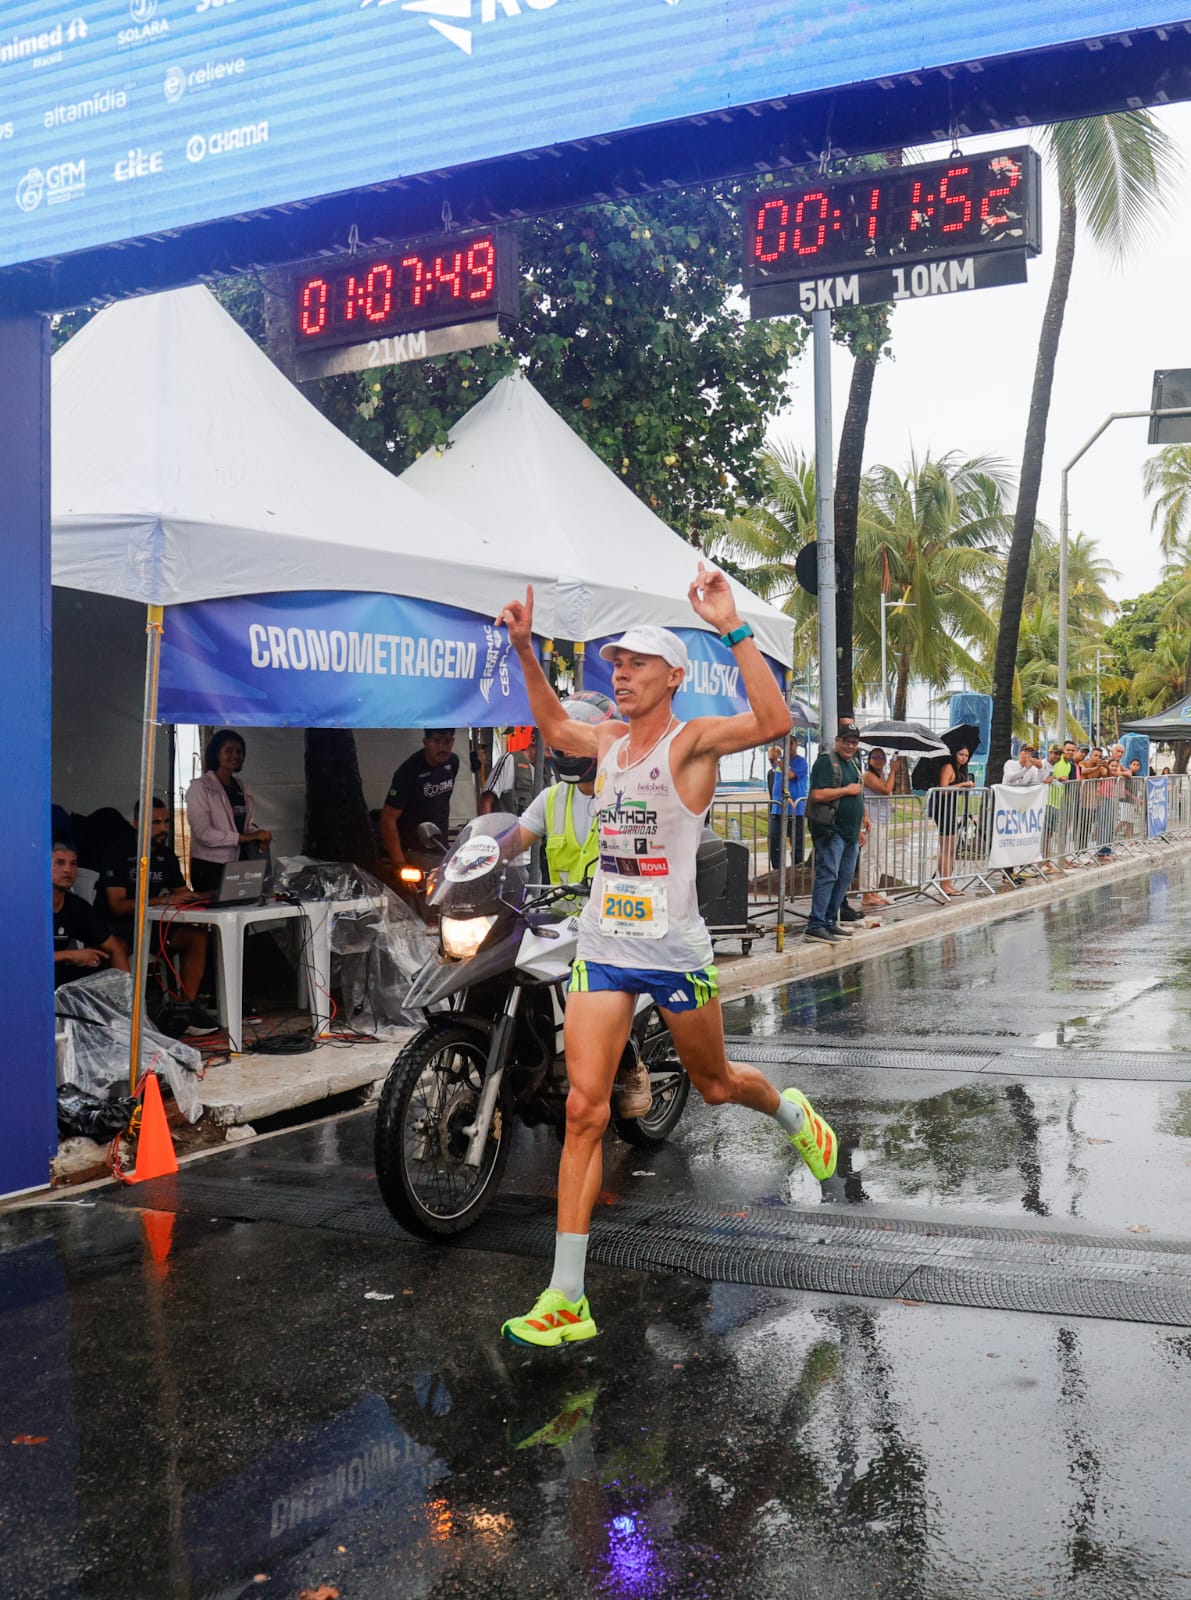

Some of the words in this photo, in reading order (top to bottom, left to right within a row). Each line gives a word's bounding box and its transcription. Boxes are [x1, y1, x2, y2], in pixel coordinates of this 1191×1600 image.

[118, 19, 169, 44] SOLARA
[188, 58, 246, 86] relieve
[44, 89, 127, 128] altamídia
[754, 160, 1019, 262] 00:11:52
[302, 240, 495, 335] 01:07:49
[799, 274, 859, 312] 5KM
[892, 258, 975, 299] 10KM
[368, 330, 427, 366] 21KM
[249, 623, 477, 680] CRONOMETRAGEM
[619, 825, 658, 836] CORRIDAS
[995, 808, 1043, 834] CESMAC
[605, 897, 646, 919] 2105
